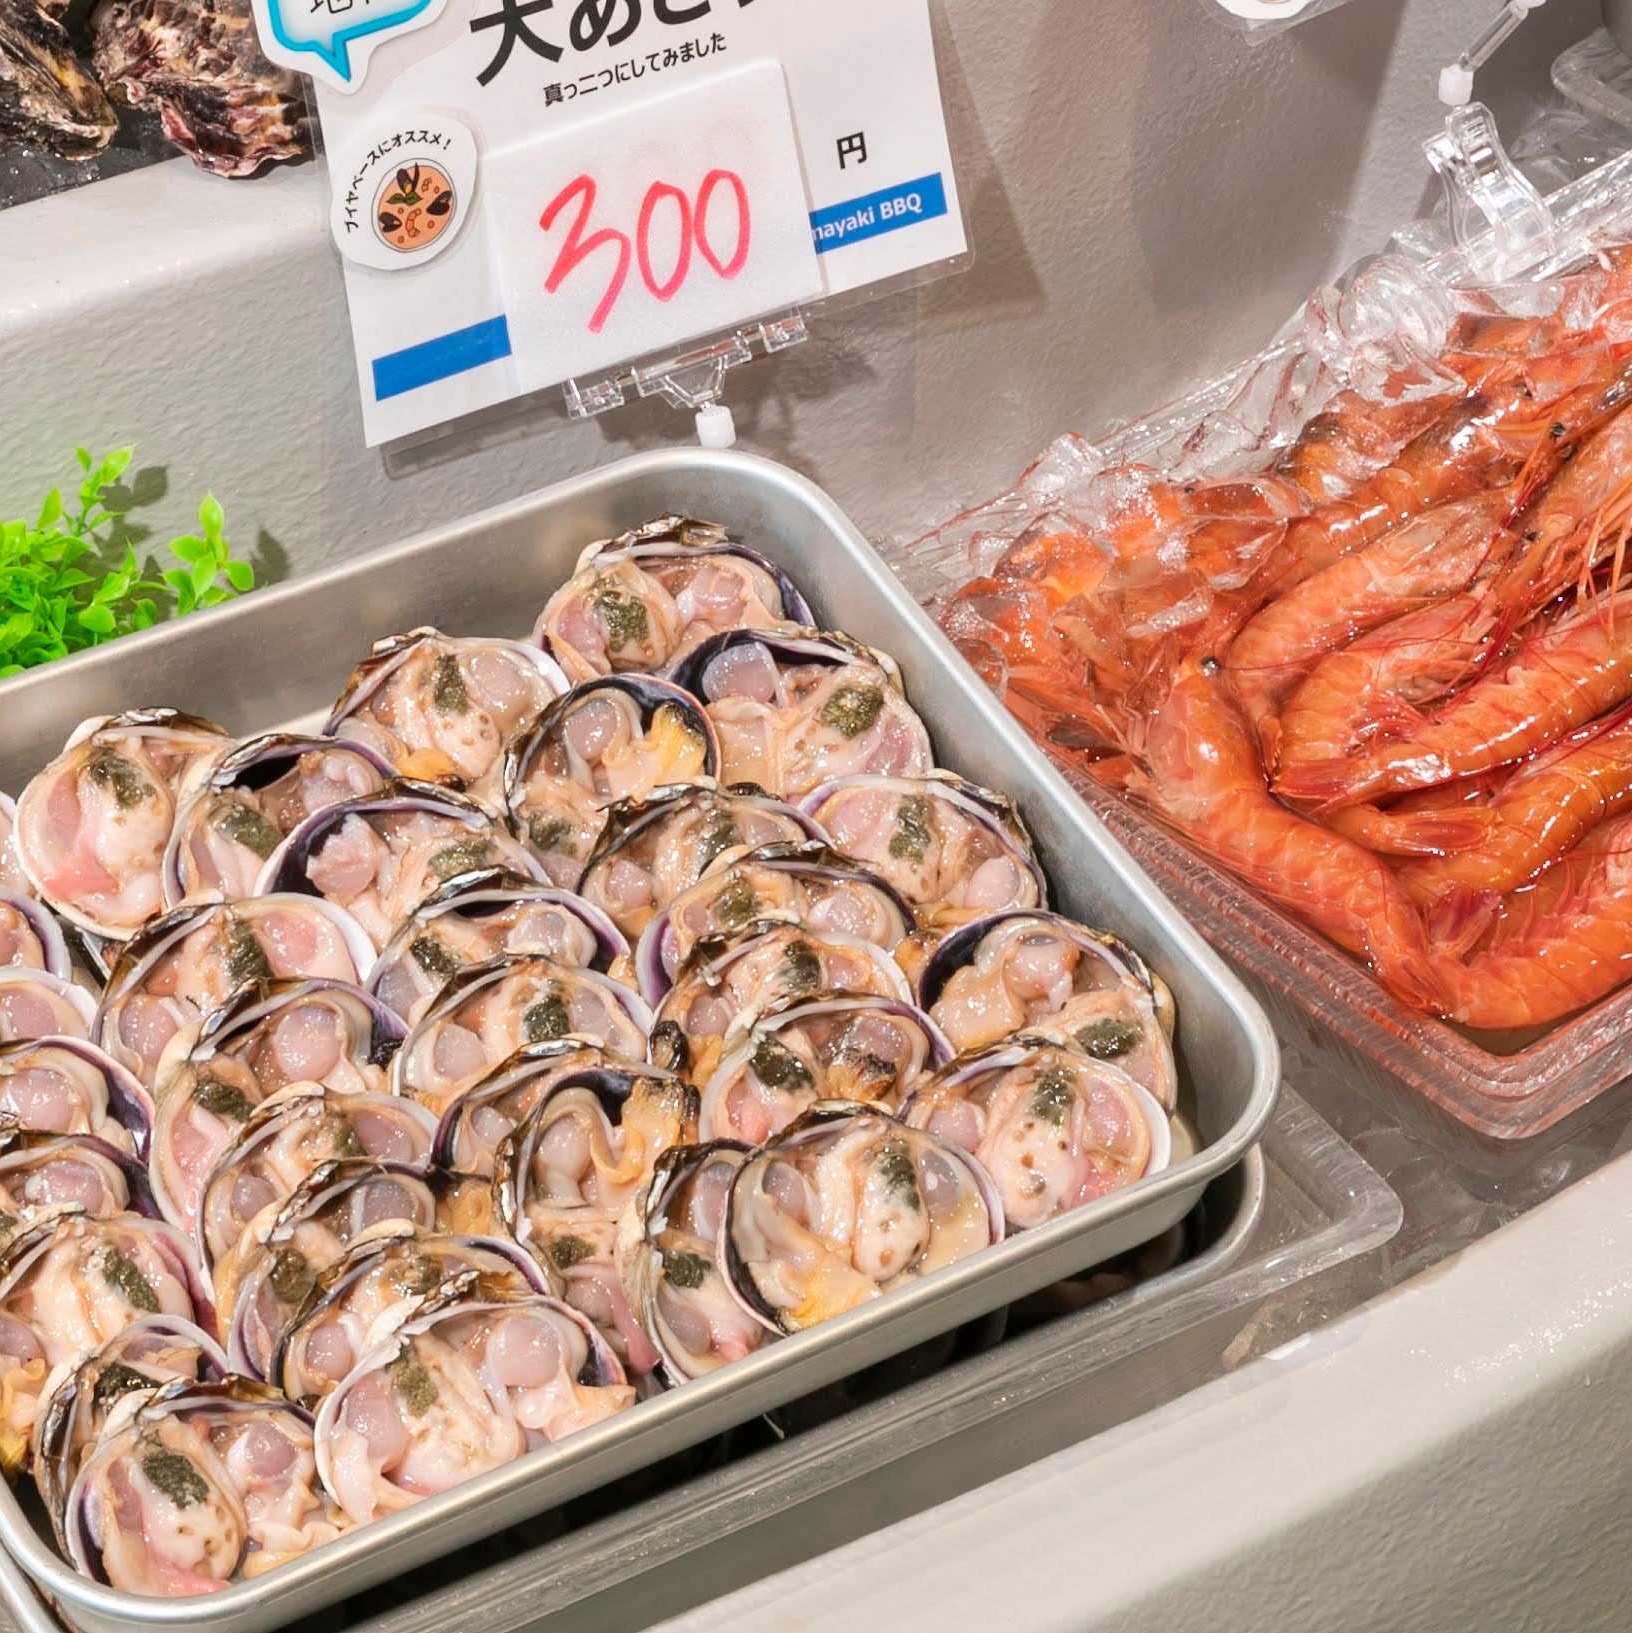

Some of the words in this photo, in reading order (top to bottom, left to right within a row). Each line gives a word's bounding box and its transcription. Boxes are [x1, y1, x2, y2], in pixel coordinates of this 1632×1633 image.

[543, 32, 728, 107] 真っ二つにしてみました
[539, 168, 751, 334] 300
[835, 130, 868, 170] 円
[879, 192, 923, 221] BBQ
